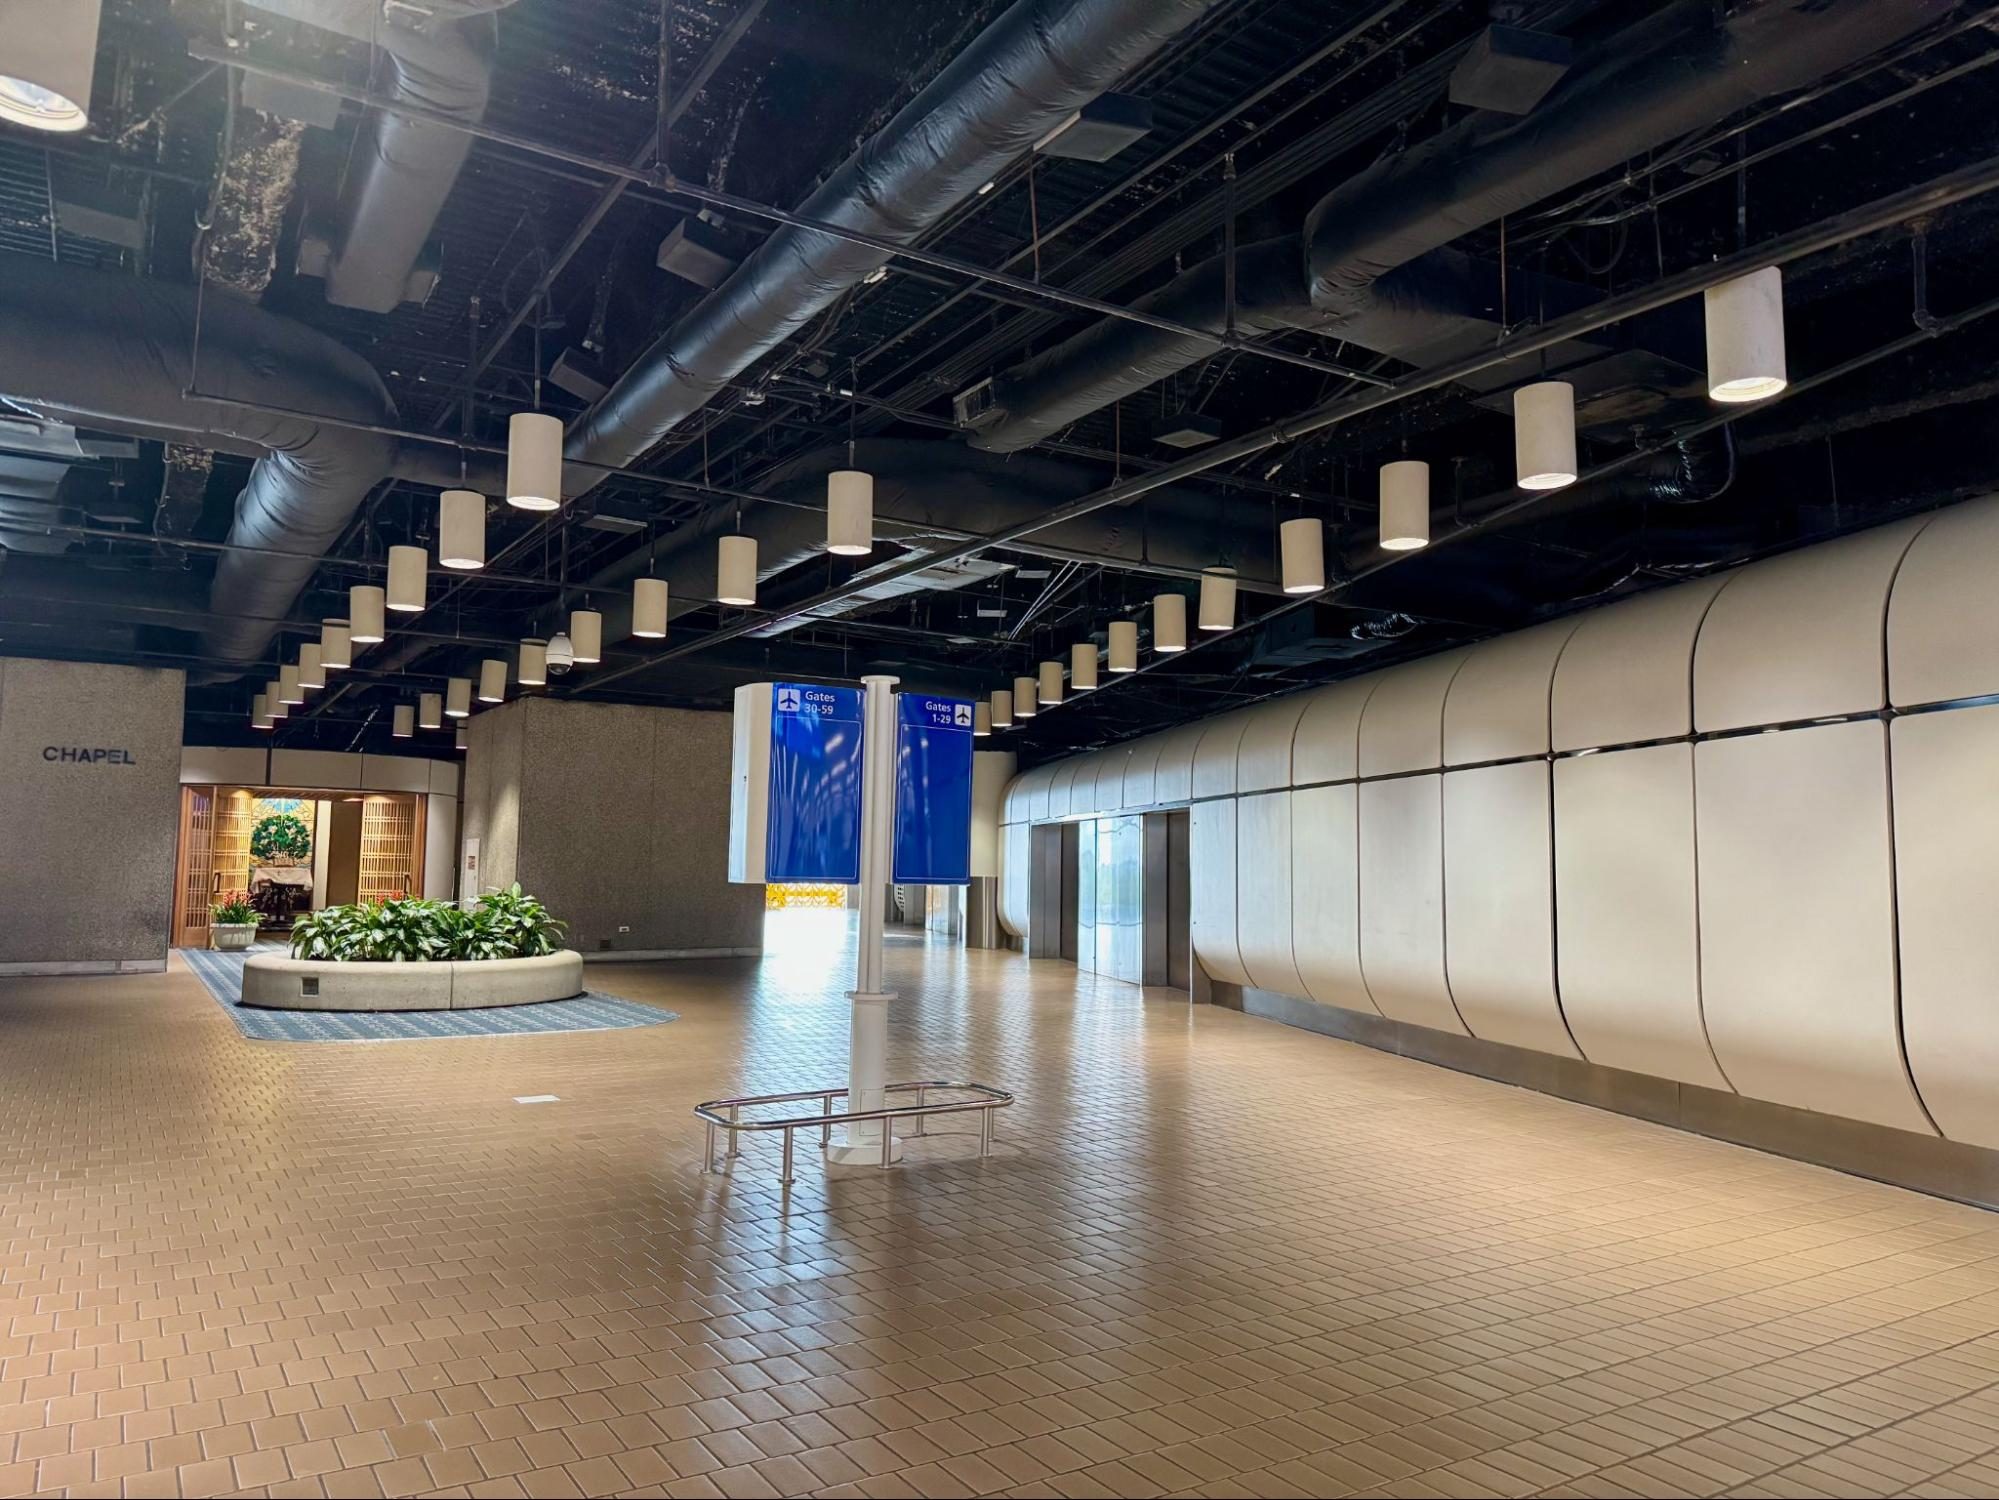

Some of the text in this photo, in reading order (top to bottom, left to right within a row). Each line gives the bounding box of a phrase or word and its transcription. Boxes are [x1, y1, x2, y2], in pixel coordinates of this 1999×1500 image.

[805, 691, 835, 702] Gates
[804, 703, 833, 714] 30-59
[925, 701, 951, 712] Gates
[932, 714, 951, 724] 1-29
[43, 746, 136, 765] CHAPEL
